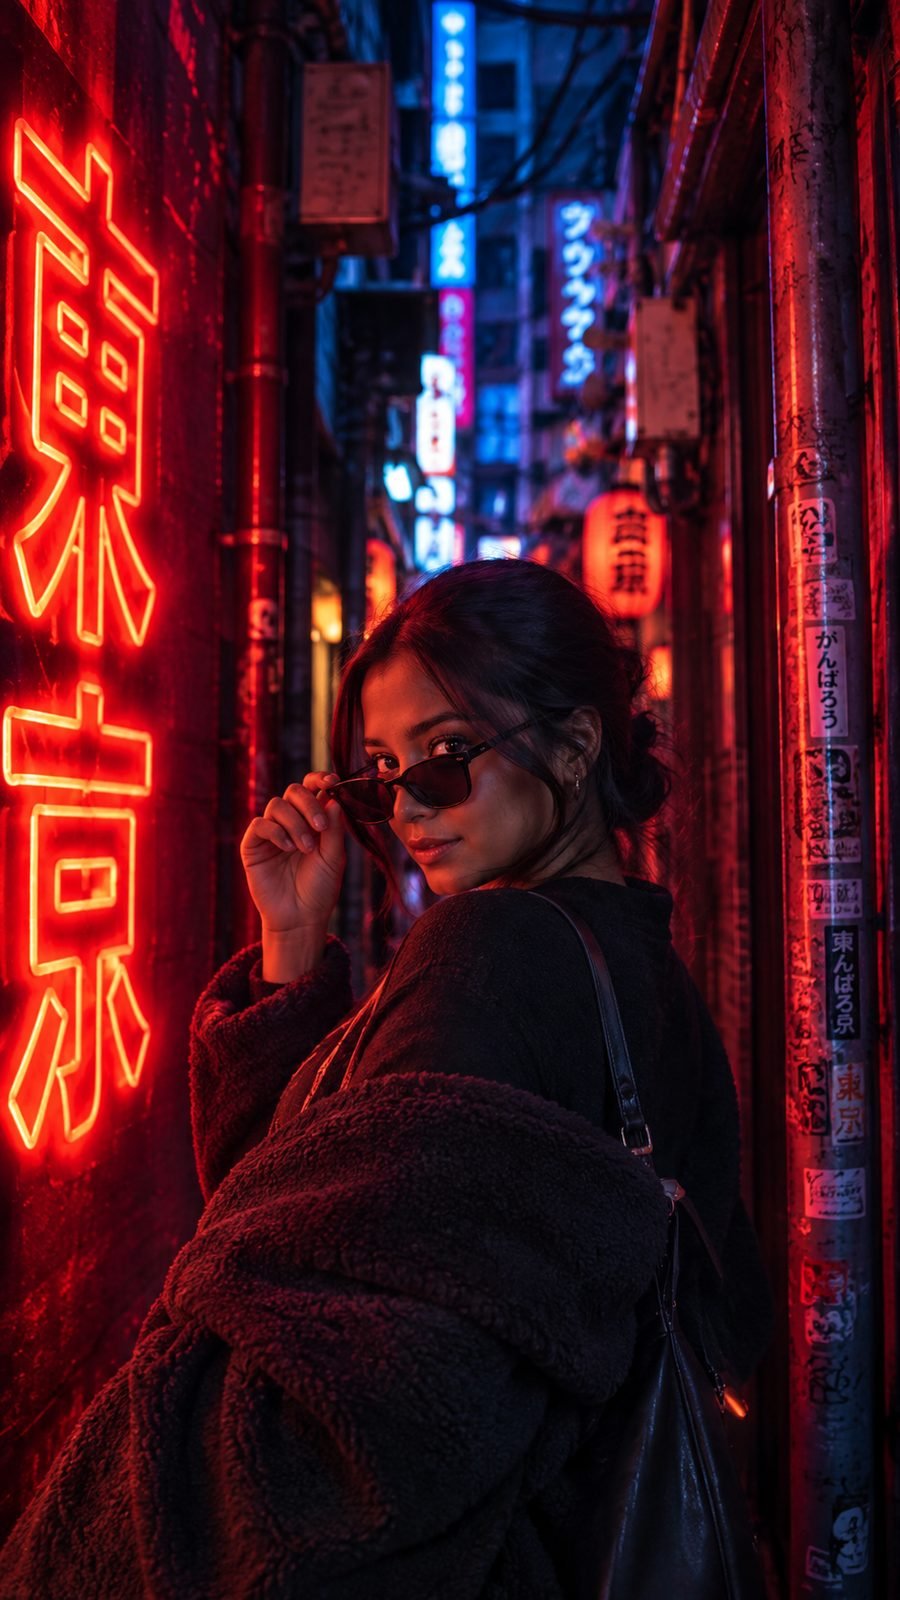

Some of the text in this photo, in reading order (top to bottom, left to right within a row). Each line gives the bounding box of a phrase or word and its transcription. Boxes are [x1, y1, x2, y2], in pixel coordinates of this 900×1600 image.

[3, 117, 159, 1150] 東京
[815, 629, 839, 730] がんばろう
[830, 930, 855, 1033] 東んばろ京
[836, 1063, 863, 1135] 東京
